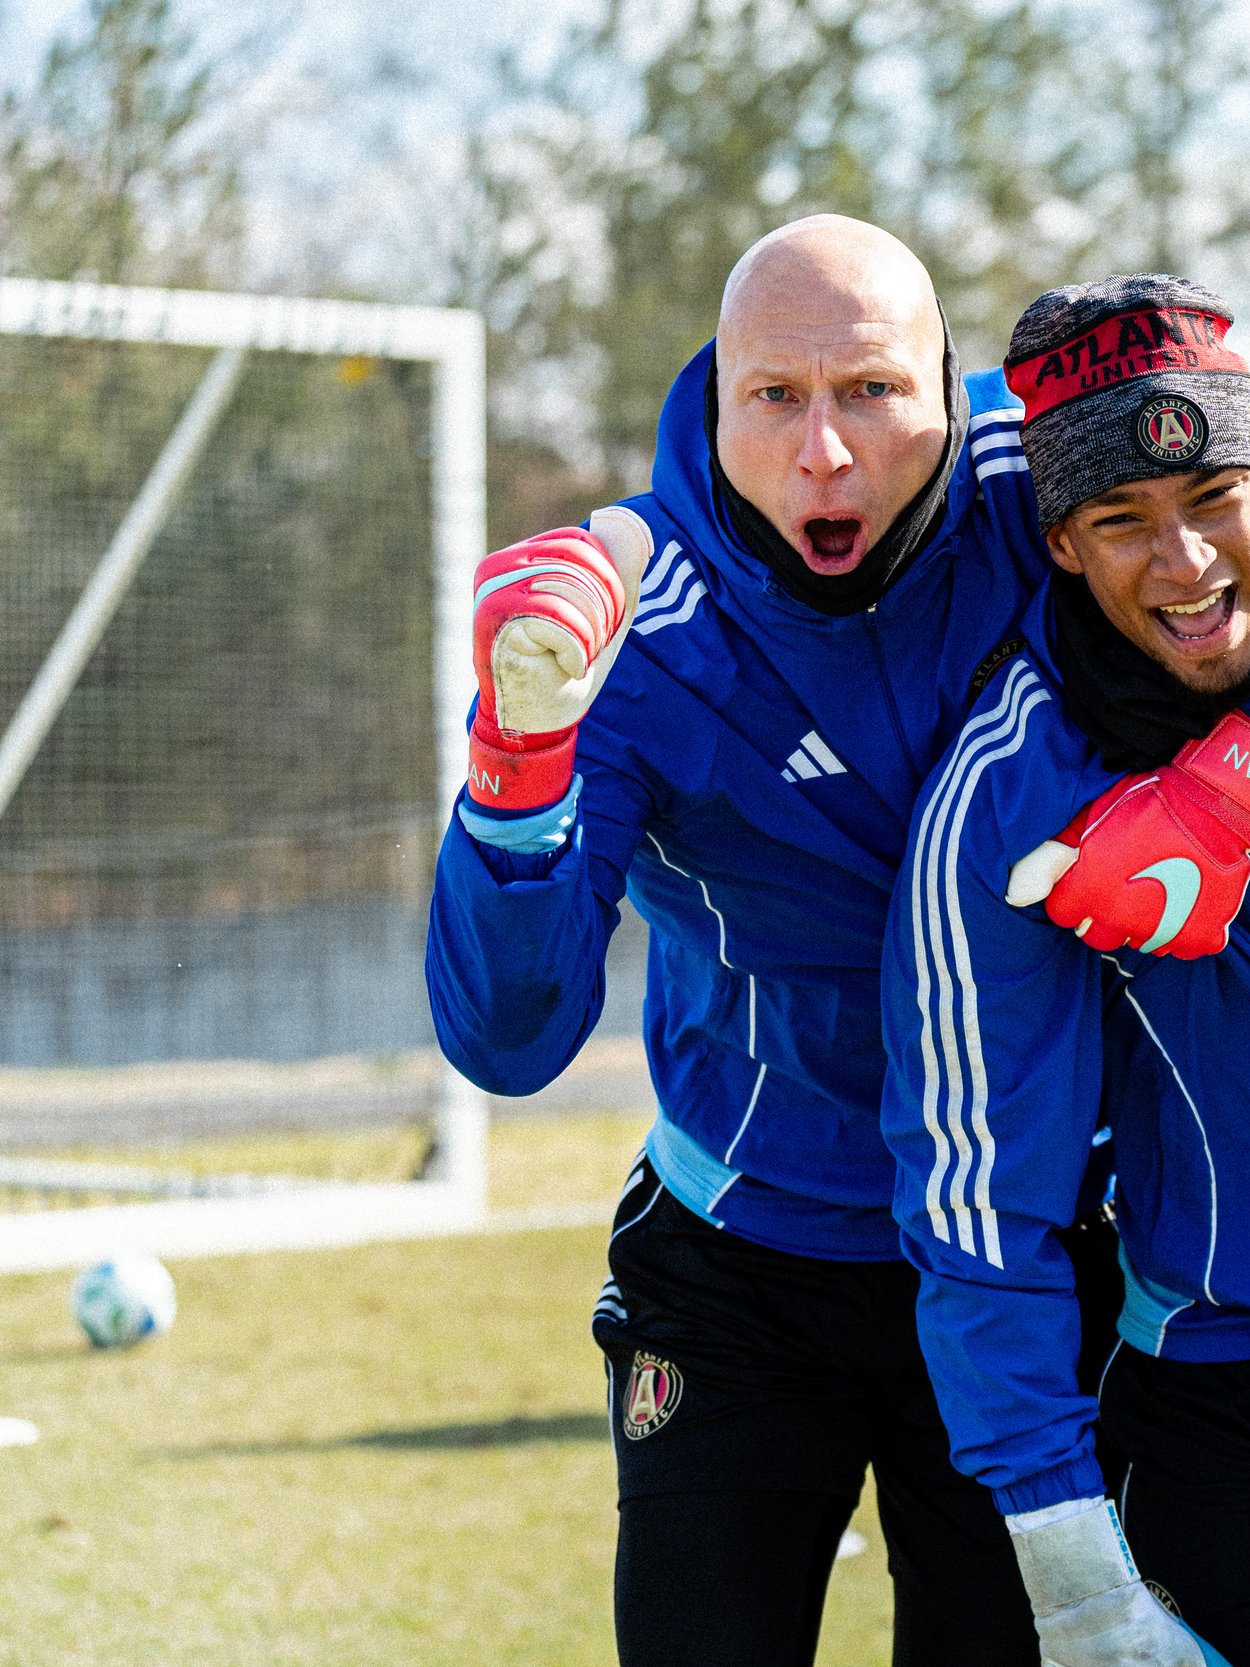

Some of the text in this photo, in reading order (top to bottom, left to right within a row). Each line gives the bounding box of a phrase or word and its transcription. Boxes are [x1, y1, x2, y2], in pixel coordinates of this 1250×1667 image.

[1081, 349, 1200, 390] UNITED
[1144, 400, 1188, 419] ATLANTA
[1160, 413, 1190, 449] A
[1150, 436, 1200, 459] UNITED FC
[653, 1408, 669, 1427] FC
